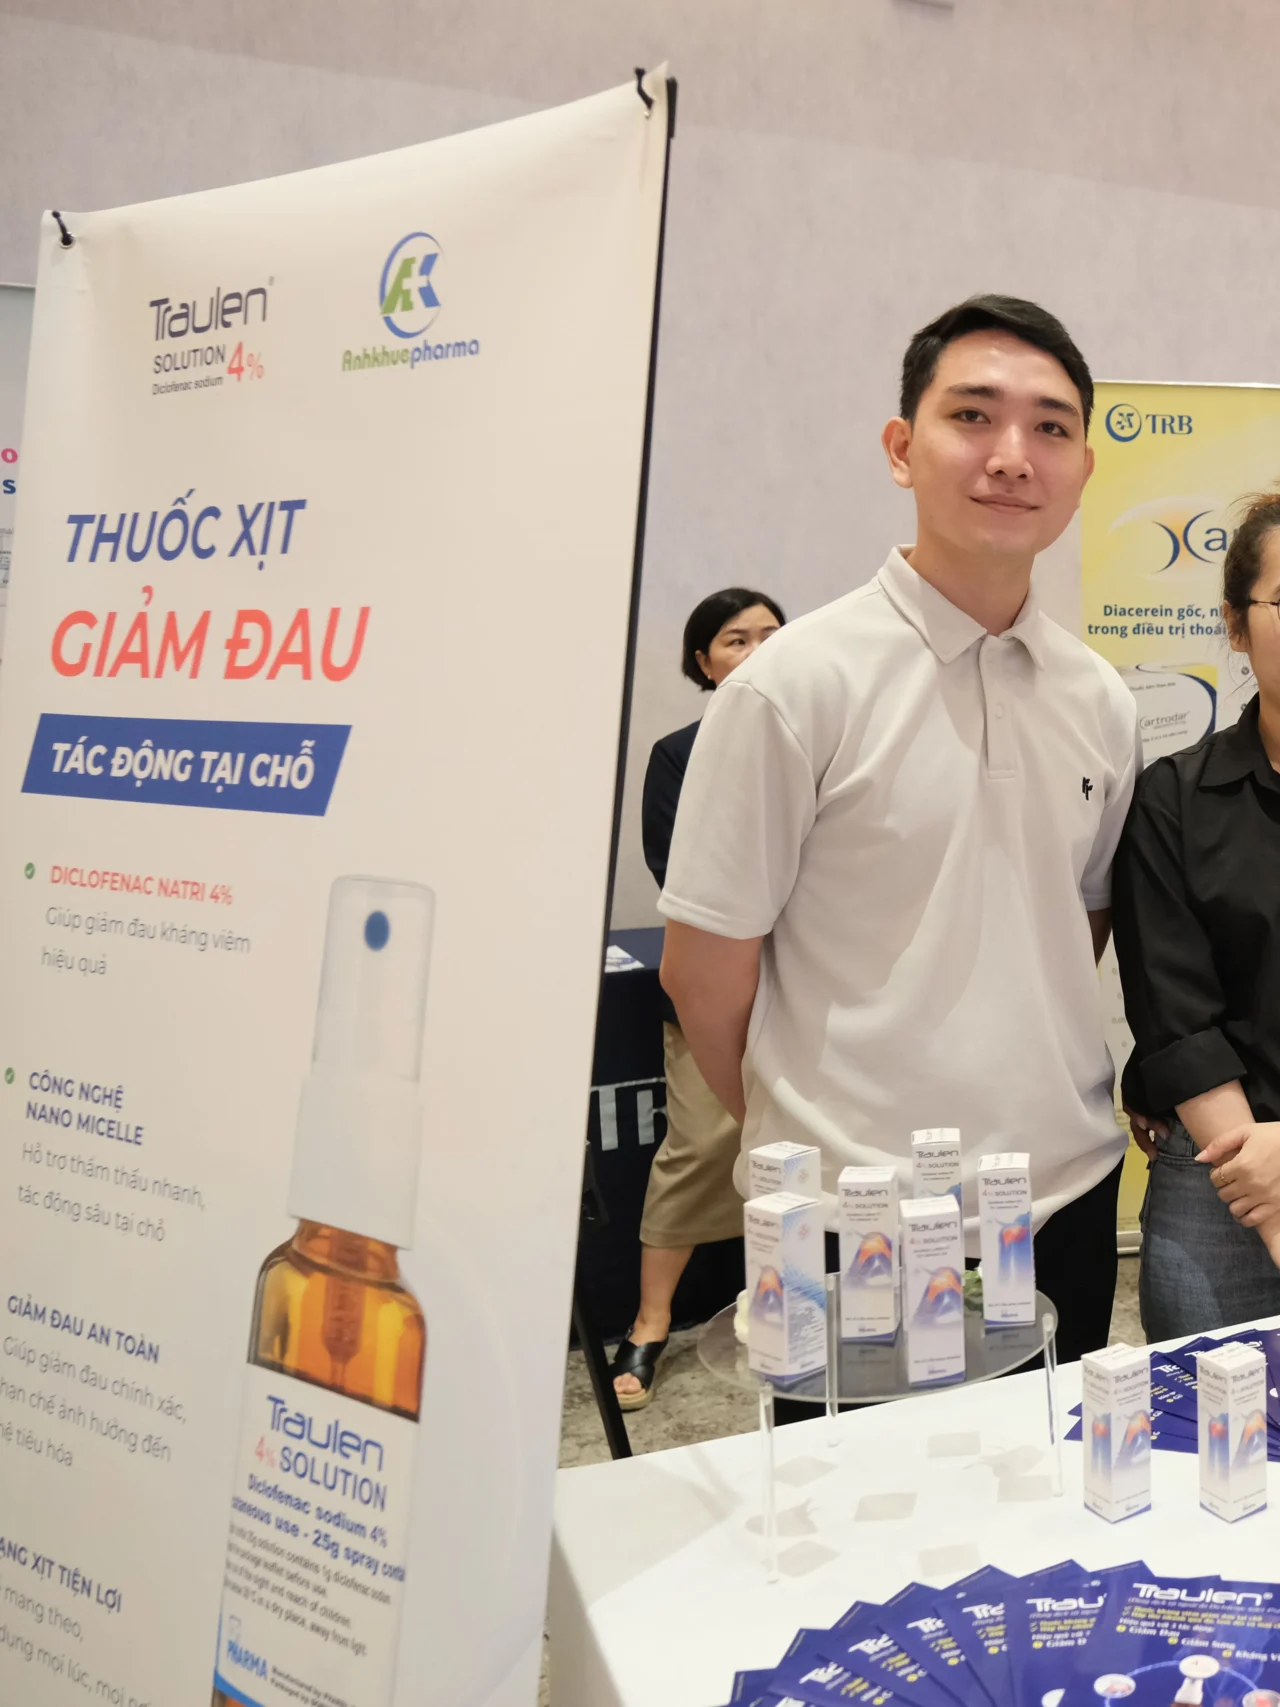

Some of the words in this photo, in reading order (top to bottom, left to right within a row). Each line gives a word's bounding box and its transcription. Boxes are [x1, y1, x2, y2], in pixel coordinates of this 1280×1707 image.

[149, 286, 268, 341] Traulen
[153, 343, 226, 375] SOLUTION
[226, 340, 265, 383] 4%
[194, 375, 224, 390] sodium
[1146, 414, 1193, 435] TRB
[66, 489, 221, 563] THUỐC
[228, 498, 307, 570] XỊT
[50, 585, 211, 678] GIẢM
[223, 606, 371, 682] ĐAU
[1088, 624, 1128, 638] trong
[1132, 622, 1164, 635] điều
[1168, 623, 1185, 638] trị
[1103, 604, 1173, 617] Diacerein
[1177, 604, 1206, 620] gốc,
[51, 736, 107, 777] TÁC
[110, 740, 193, 787] ĐỘNG
[199, 750, 245, 793] TẠI
[249, 739, 316, 790] CHỖ
[50, 864, 155, 896] DICLOFENAC
[157, 877, 206, 903] NATRI
[209, 883, 234, 906] 4%
[45, 905, 83, 934] Giúp
[85, 911, 124, 937] giảm
[127, 917, 157, 940] đau
[160, 920, 208, 952] kháng
[212, 928, 251, 953] viêm
[41, 946, 75, 973] hiệu
[78, 952, 107, 977] quả
[29, 1069, 74, 1099] CÔNG
[79, 1081, 124, 1113] NGHỆ
[25, 1101, 73, 1128] NANO
[76, 1113, 145, 1146] MICELLE
[916, 1150, 959, 1158] Traulen
[151, 1176, 206, 1212] nhanh,
[841, 1189, 888, 1197] Traulen
[982, 1177, 1027, 1185] Traulen
[18, 1184, 40, 1206] tác
[43, 1189, 81, 1222] động
[85, 1201, 112, 1226] sâu
[114, 1212, 135, 1238] tại
[909, 1222, 958, 1232] Traulen
[7, 1293, 46, 1324] GIẢM
[49, 1309, 84, 1336] ĐAU
[87, 1323, 111, 1347] AN
[114, 1330, 160, 1363] TOÀN
[3, 1336, 36, 1367] Giúp
[79, 1364, 109, 1391] đau
[111, 1377, 154, 1408] chính
[156, 1396, 187, 1426] xác,
[47, 1438, 73, 1467] hóa
[141, 1434, 171, 1463] đến
[266, 1394, 384, 1472] Traulen
[279, 1446, 388, 1512] SOLUTION
[248, 1473, 311, 1515] Diclofenac
[315, 1506, 367, 1539] sodium
[369, 1525, 389, 1549] 4%
[275, 1516, 300, 1538] use
[312, 1528, 340, 1560] 25g
[343, 1546, 380, 1576] spray
[31, 1552, 55, 1581] XỊT
[58, 1564, 93, 1599] TIỆN
[96, 1584, 123, 1614] LỢI
[5, 1586, 45, 1624] mang
[48, 1607, 84, 1643] theo,
[36, 1648, 65, 1677] mọi
[68, 1658, 93, 1695] lúc,
[95, 1680, 125, 1707] mọi
